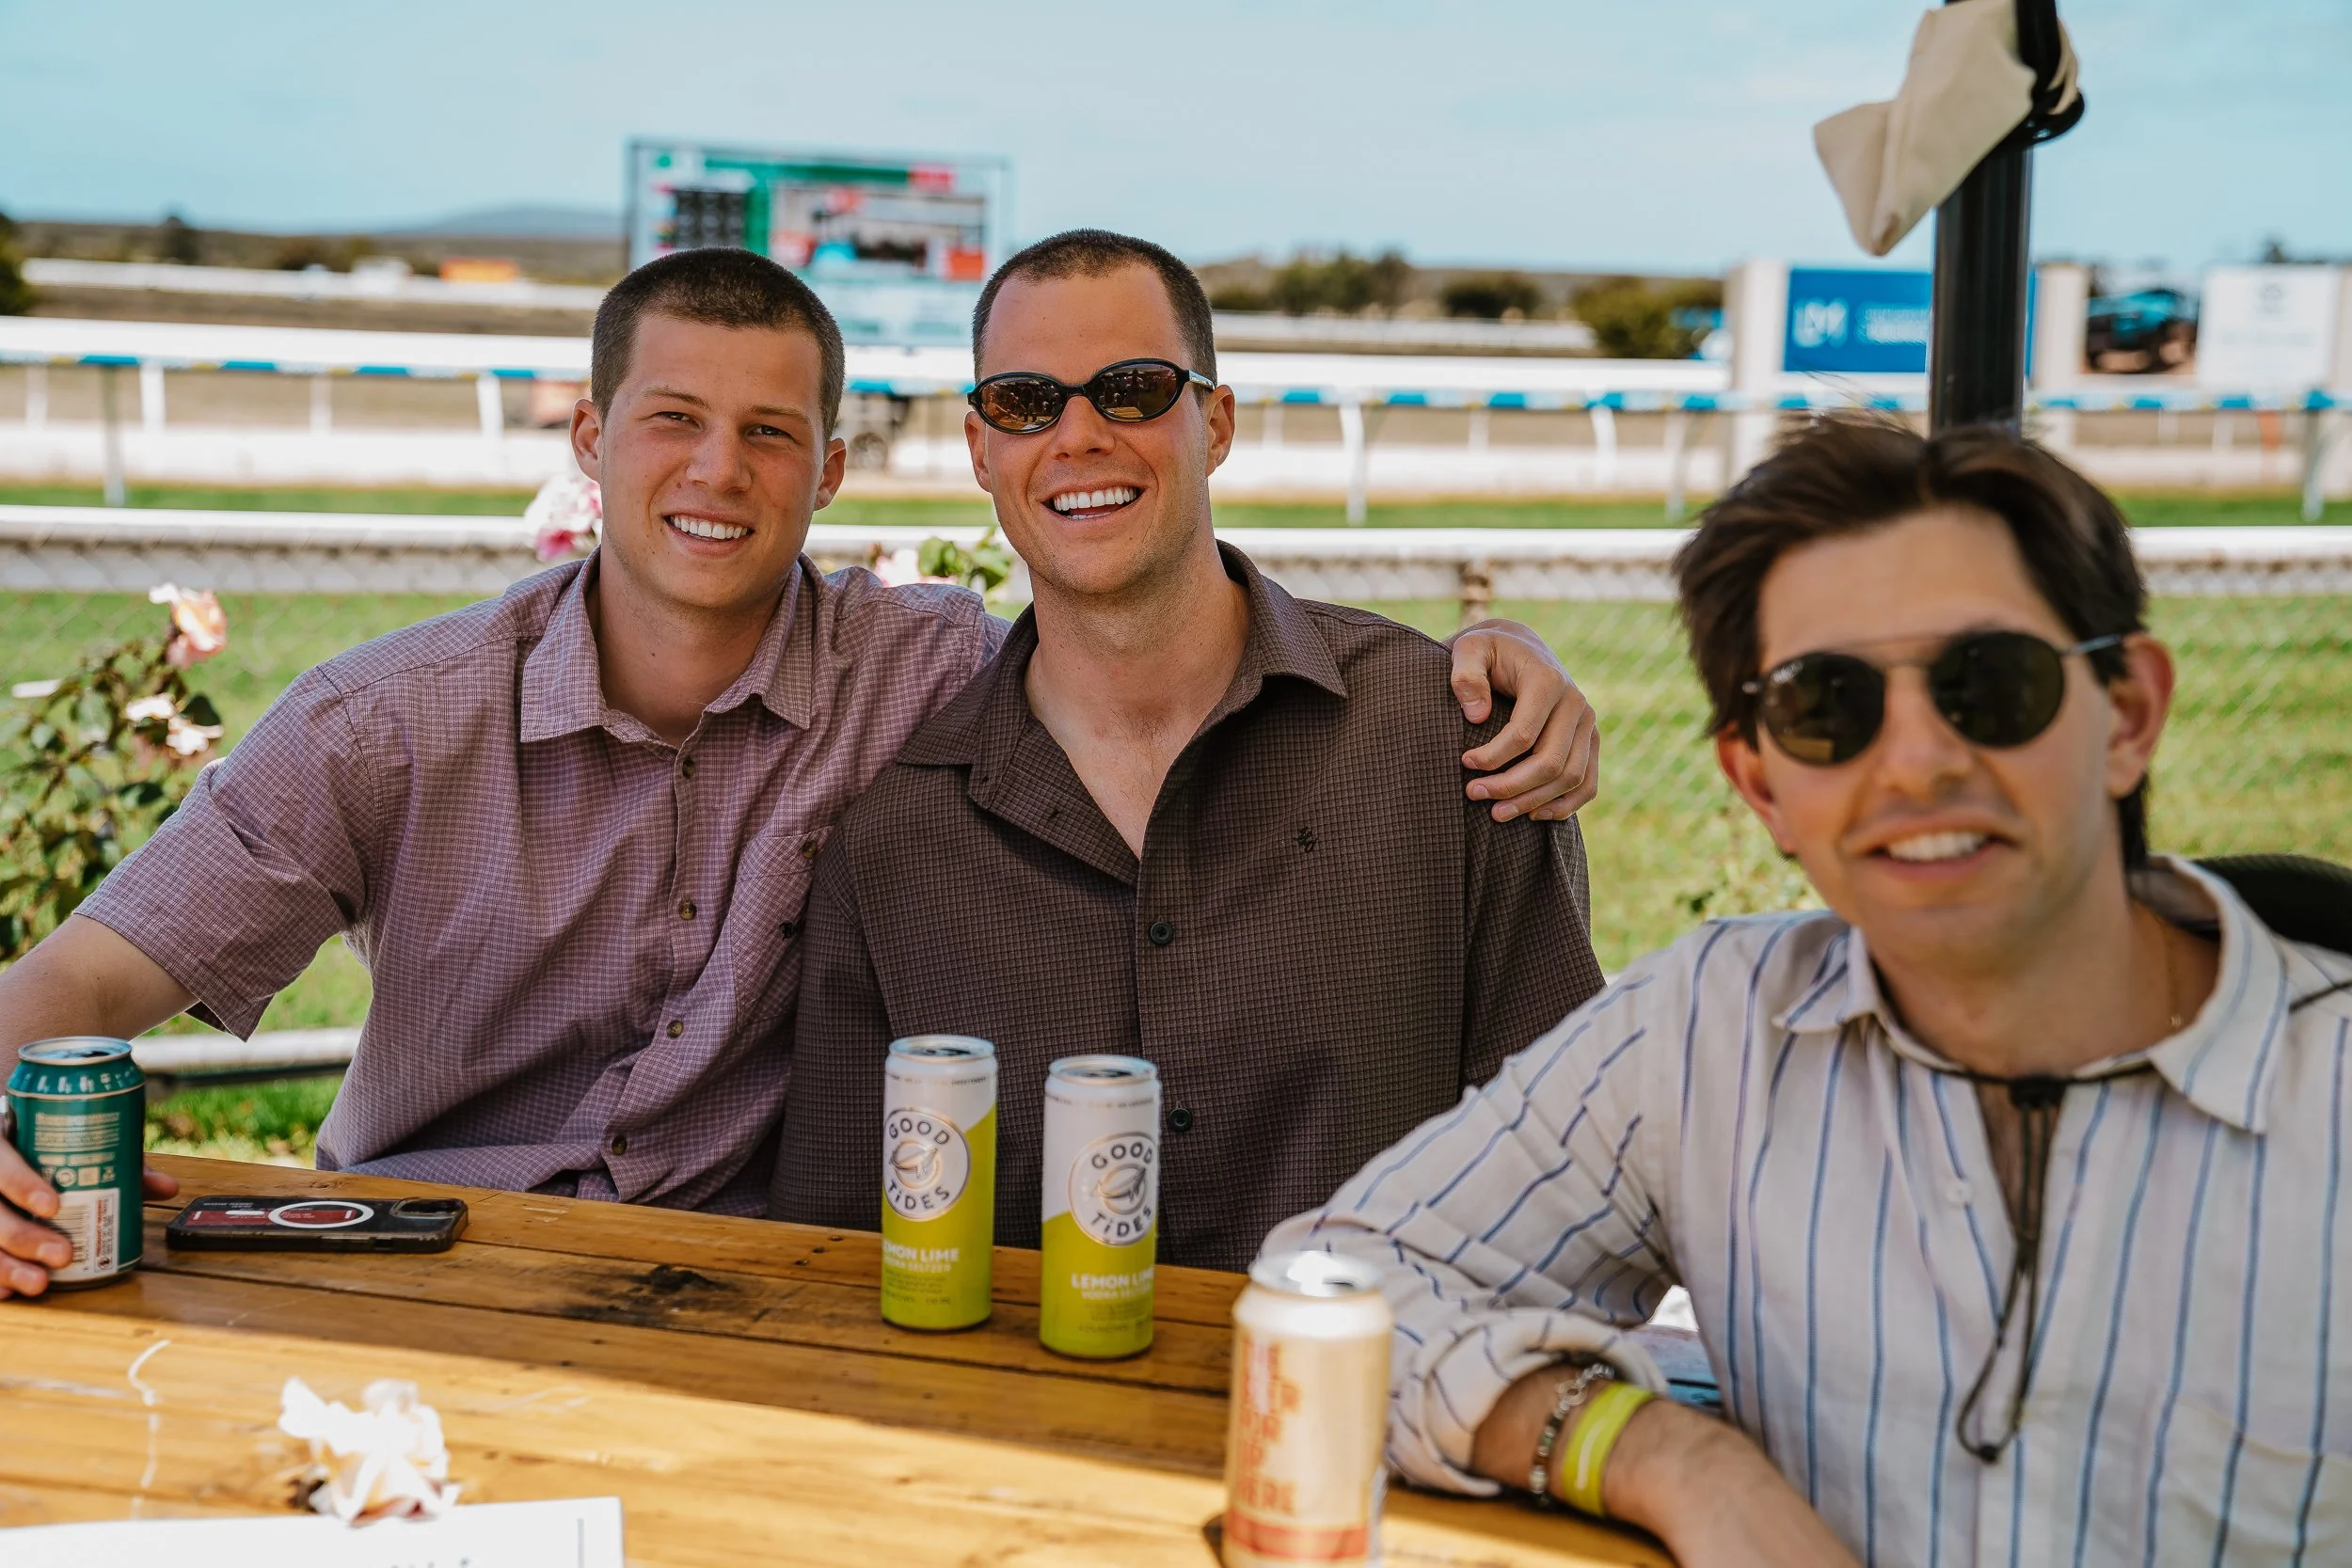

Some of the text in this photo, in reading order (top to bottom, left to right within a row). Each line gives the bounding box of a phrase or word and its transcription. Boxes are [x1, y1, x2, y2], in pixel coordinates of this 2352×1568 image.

[889, 1117, 950, 1145] GOOD
[1091, 1141, 1152, 1169] GOOD
[920, 1247, 960, 1263] LIME
[1071, 1272, 1129, 1290] LEMON
